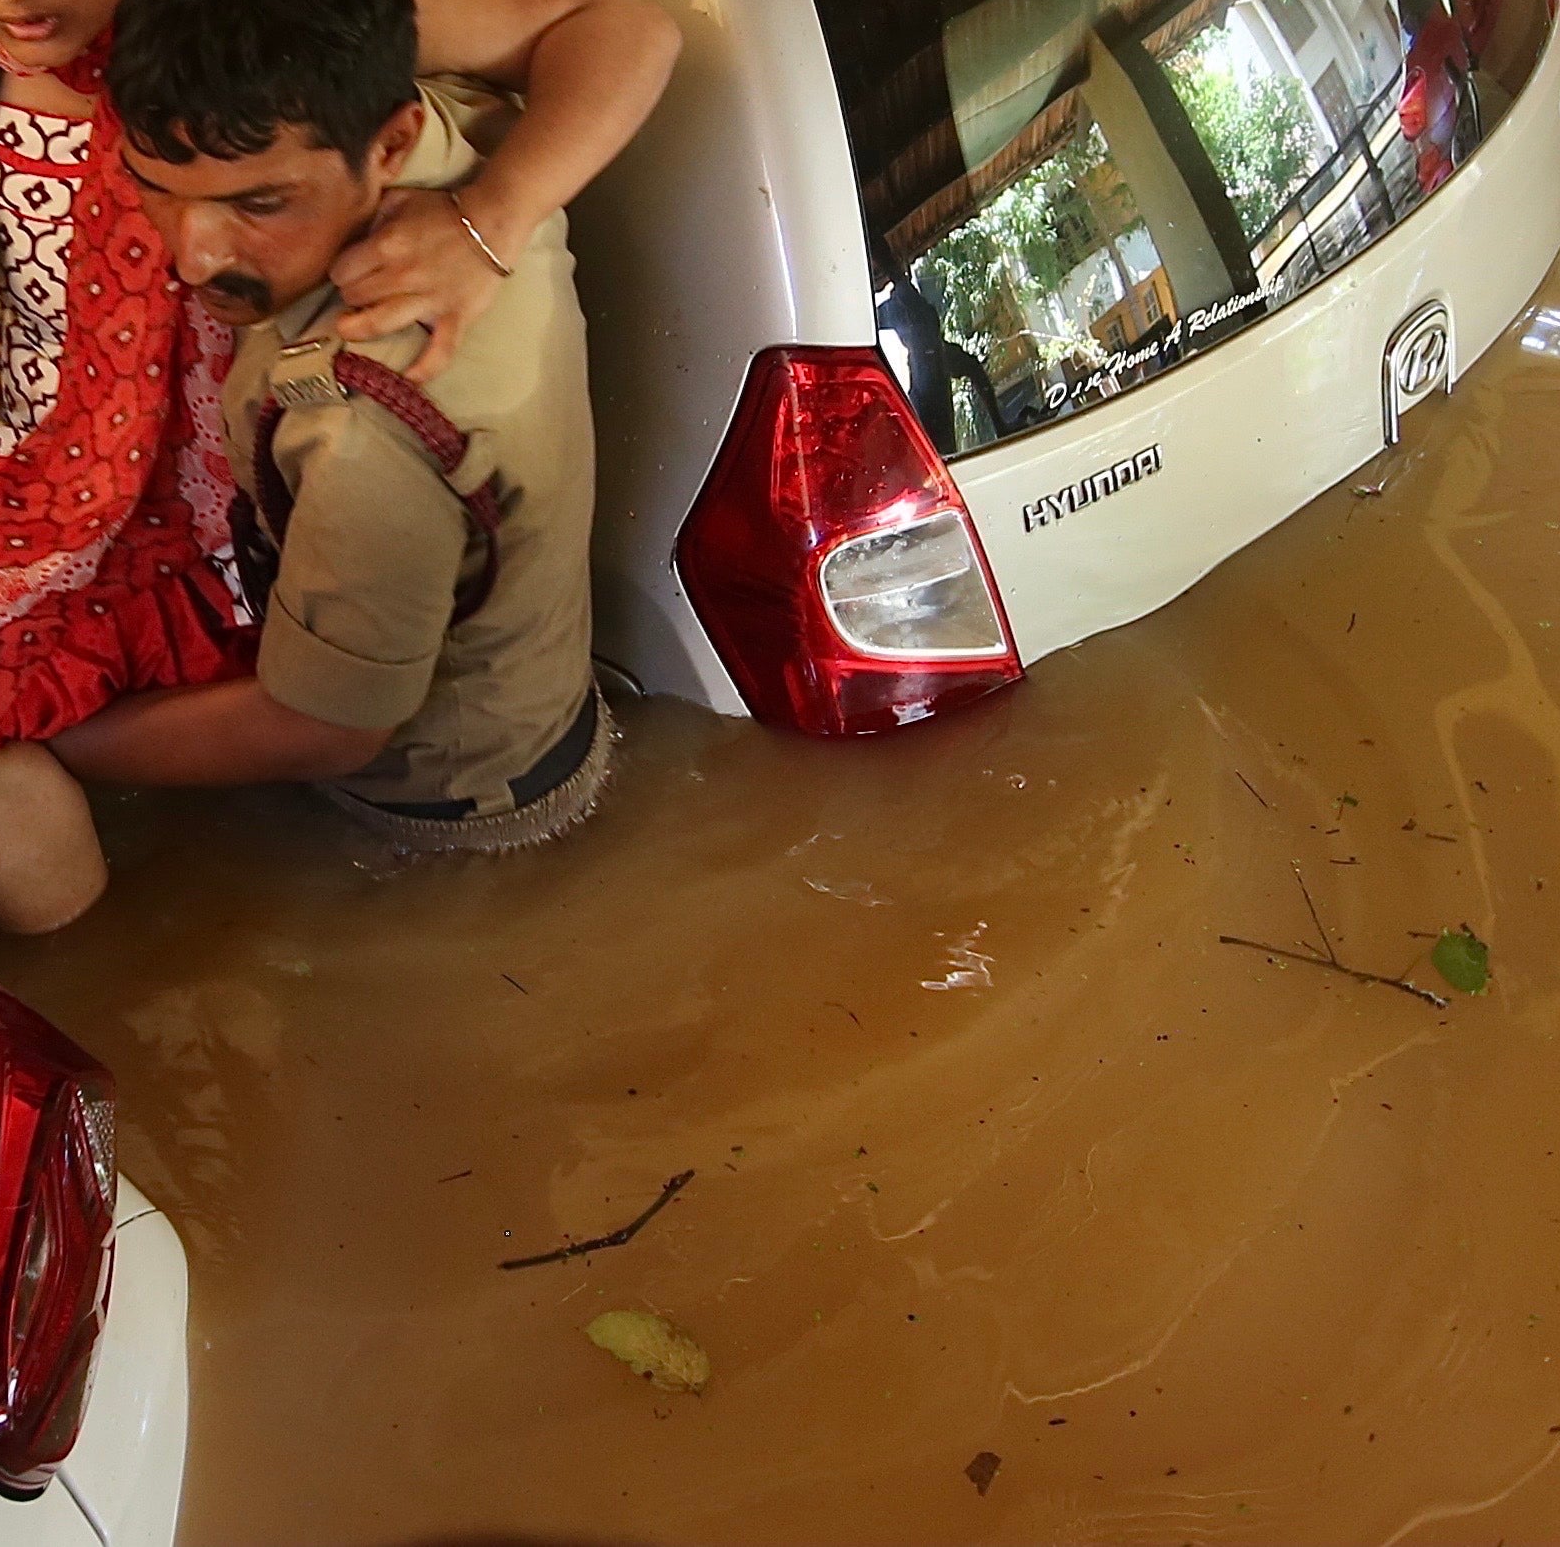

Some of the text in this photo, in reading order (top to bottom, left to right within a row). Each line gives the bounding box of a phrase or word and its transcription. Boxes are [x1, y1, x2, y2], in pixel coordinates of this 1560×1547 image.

[1105, 341, 1159, 377] Home
[1163, 320, 1183, 352] A
[1187, 275, 1285, 338] Relationship
[1022, 442, 1164, 534] HYUNDAI
